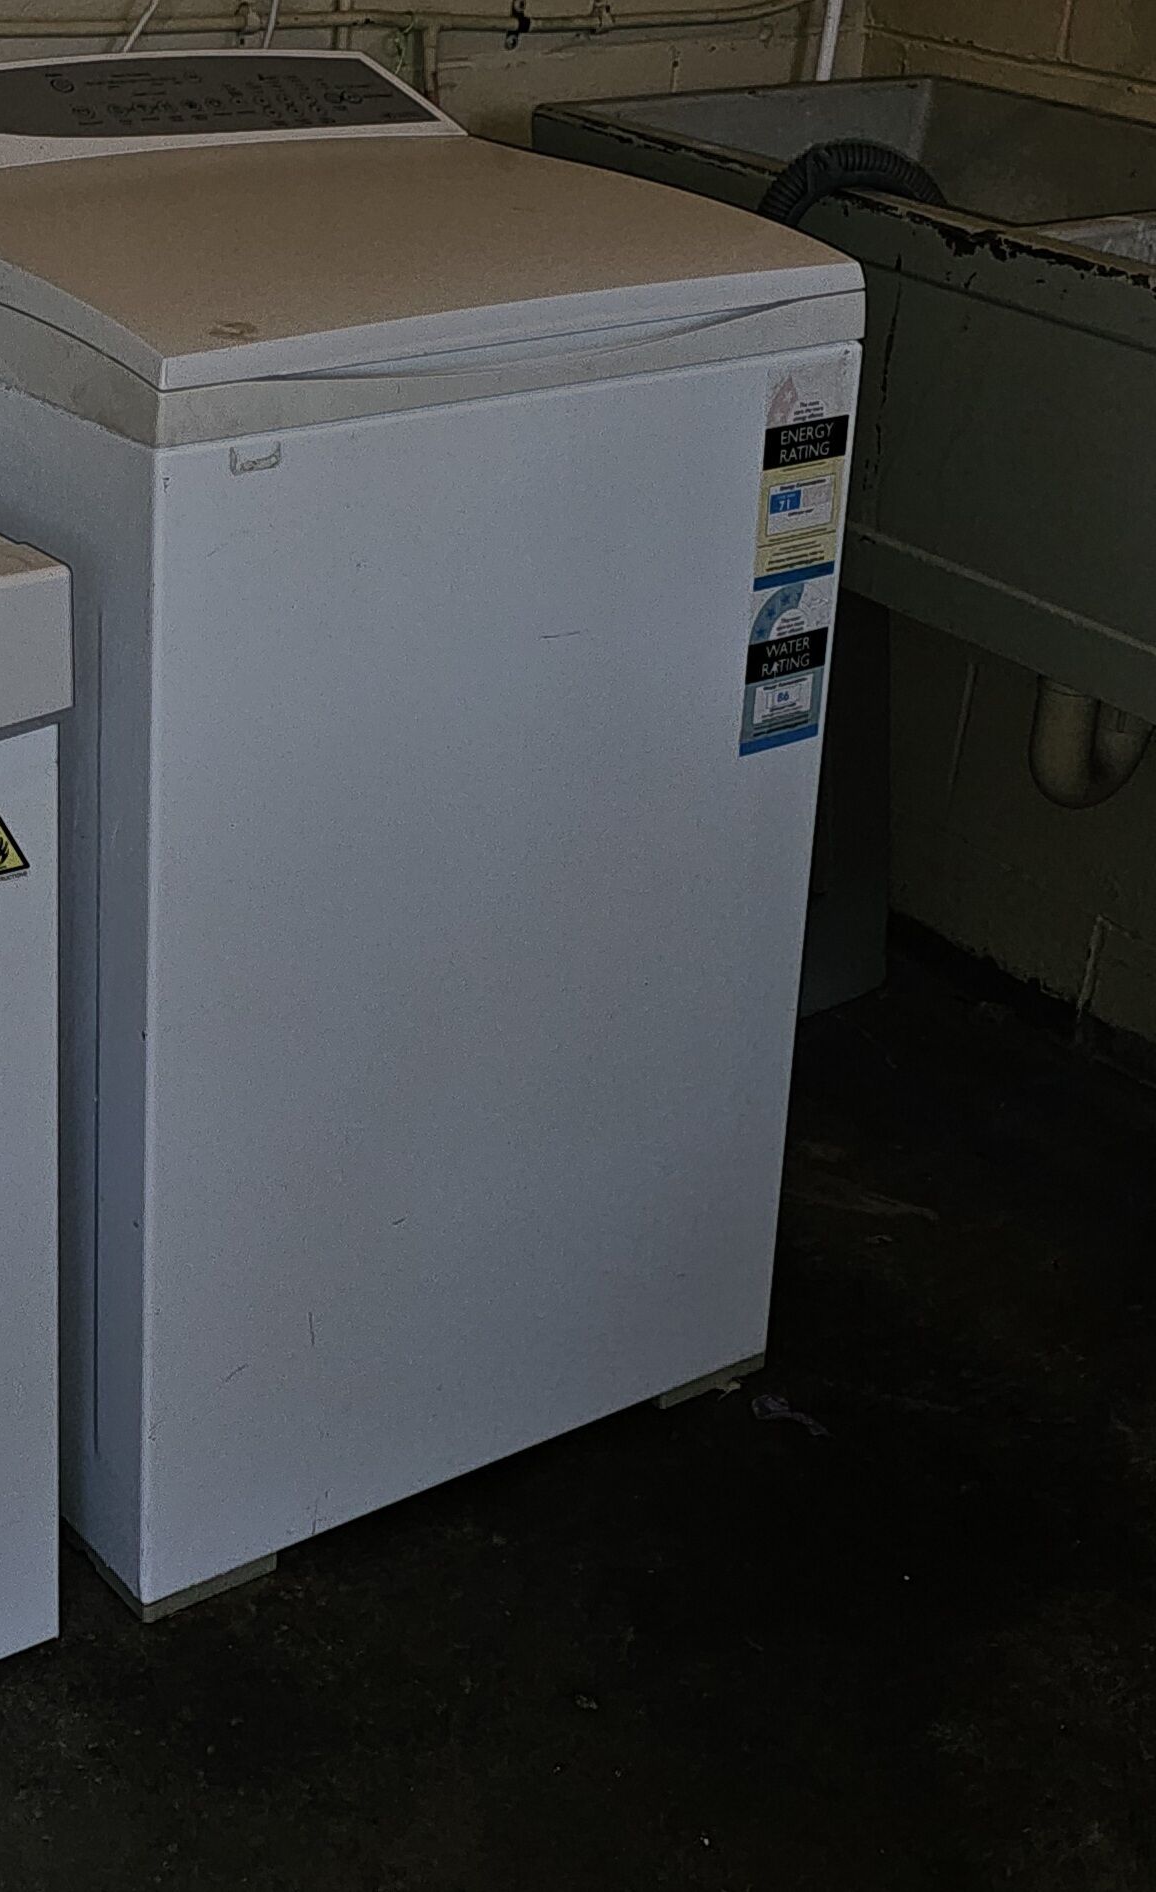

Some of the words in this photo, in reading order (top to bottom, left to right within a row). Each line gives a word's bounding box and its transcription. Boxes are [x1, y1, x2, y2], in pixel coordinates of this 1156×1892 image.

[780, 422, 834, 446] ENERGY
[779, 441, 831, 464] RATING
[778, 498, 791, 511] 71
[766, 636, 811, 658] WATER
[761, 652, 811, 678] RATING
